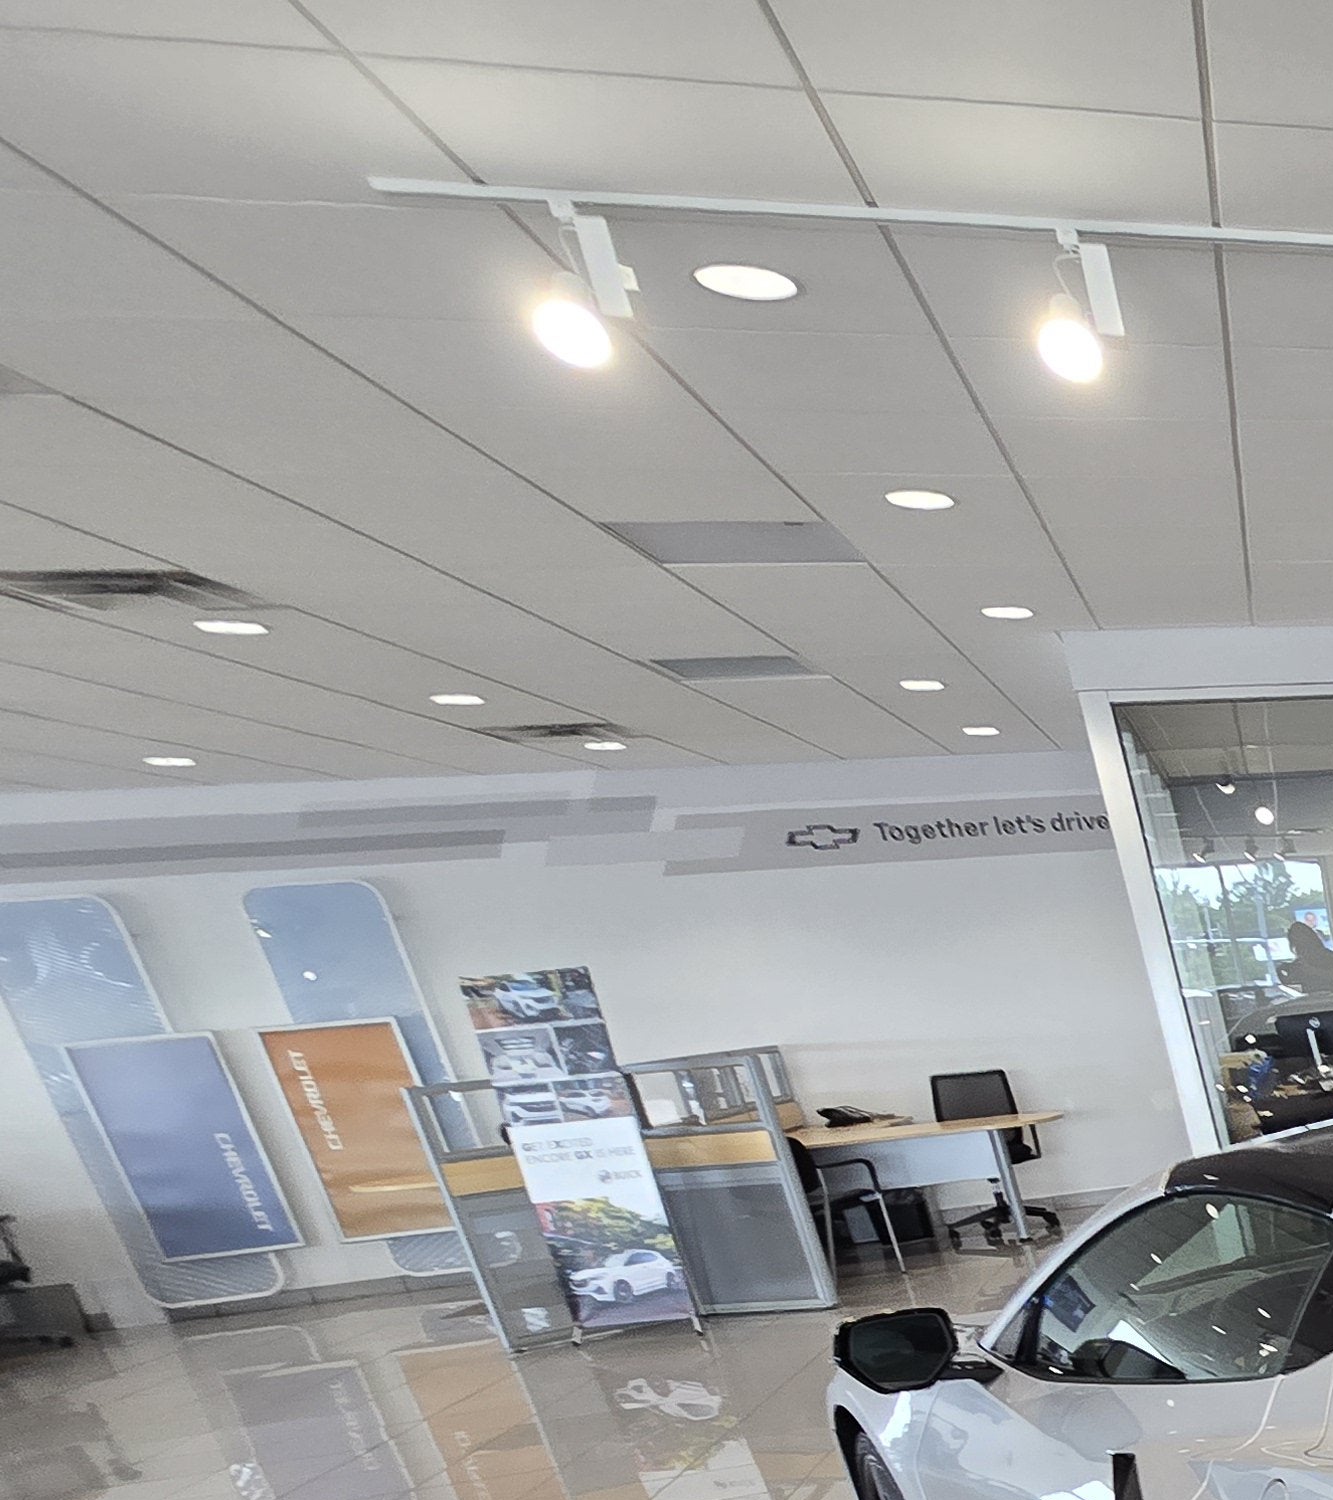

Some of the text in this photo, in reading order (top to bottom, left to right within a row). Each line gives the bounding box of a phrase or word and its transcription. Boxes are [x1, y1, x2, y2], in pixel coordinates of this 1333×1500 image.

[873, 811, 1110, 845] Together let's drive
[287, 1049, 343, 1150] CHEVROLET
[213, 1132, 272, 1231] CHEVROLET
[574, 1150, 593, 1160] GX
